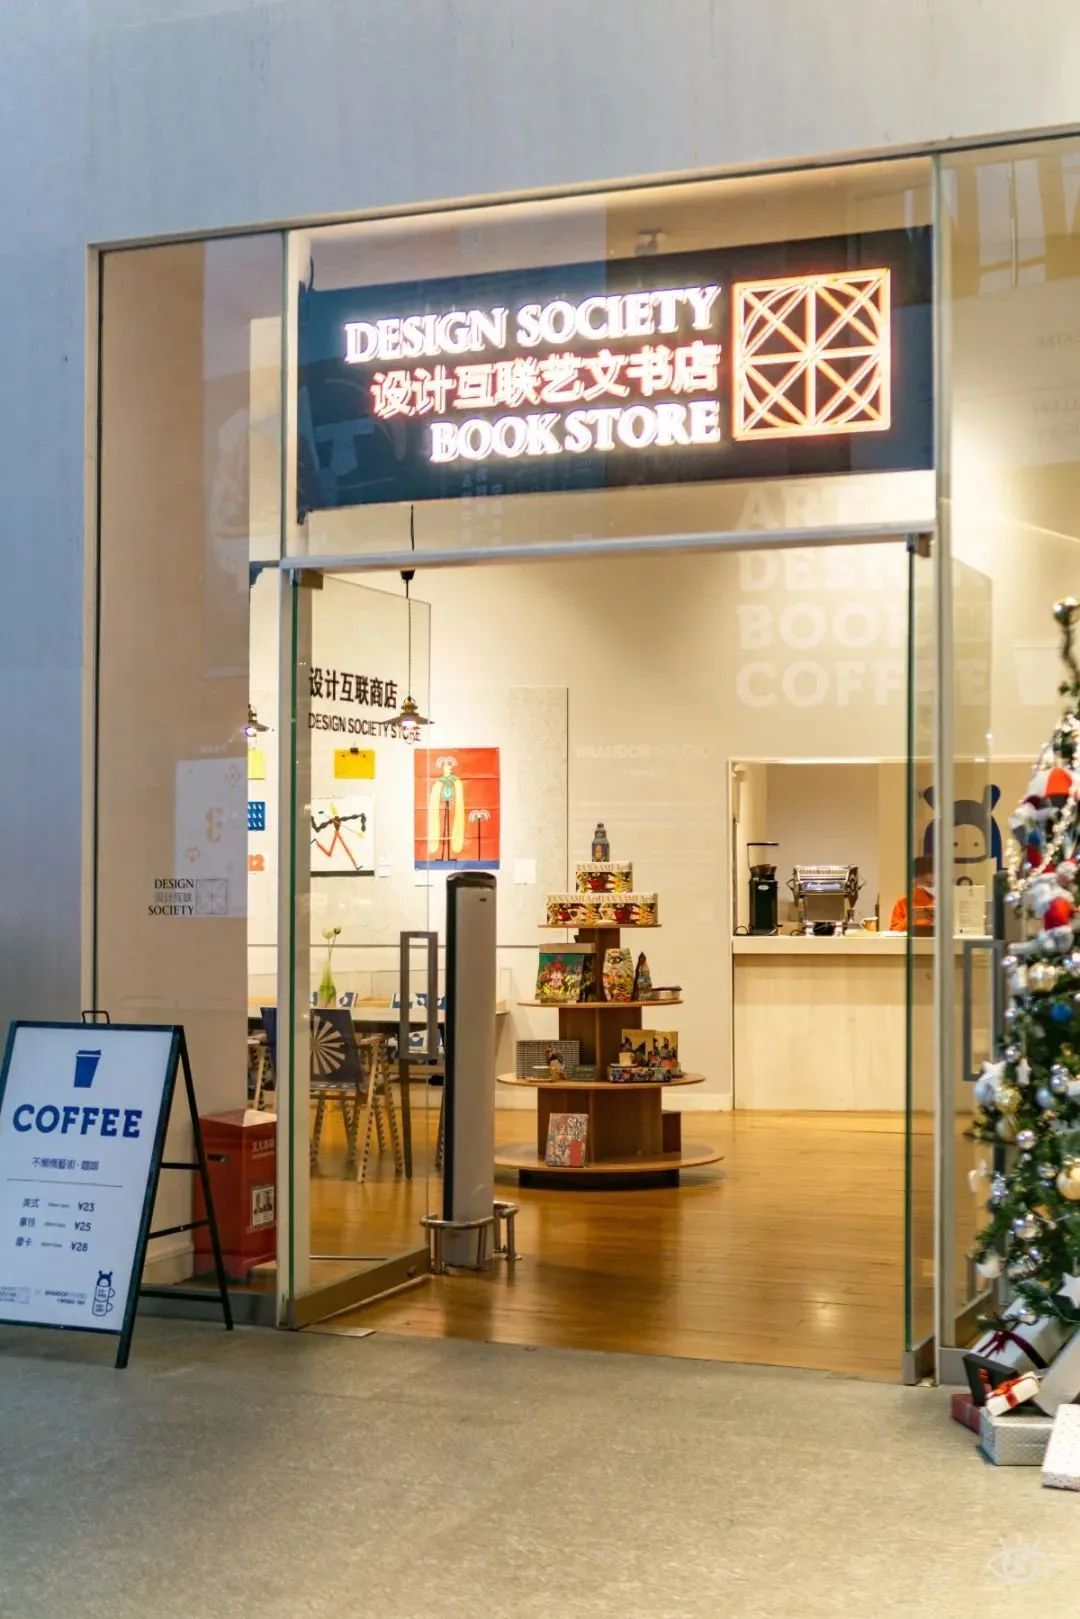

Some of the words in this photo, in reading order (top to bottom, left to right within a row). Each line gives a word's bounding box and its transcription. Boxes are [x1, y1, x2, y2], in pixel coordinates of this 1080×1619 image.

[344, 306, 507, 365] DESIGN
[516, 284, 722, 346] SOCIETY
[369, 340, 722, 419] 设计互联艺文书店
[430, 409, 563, 465] BOOK
[564, 400, 722, 455] STORE
[308, 666, 398, 709] 设计互联商店
[308, 712, 346, 733] DESIGN
[347, 718, 390, 738] SOCIETY
[154, 879, 195, 889] DESIGN
[147, 905, 195, 916] SOCIETY
[12, 1103, 144, 1139] COFFEE
